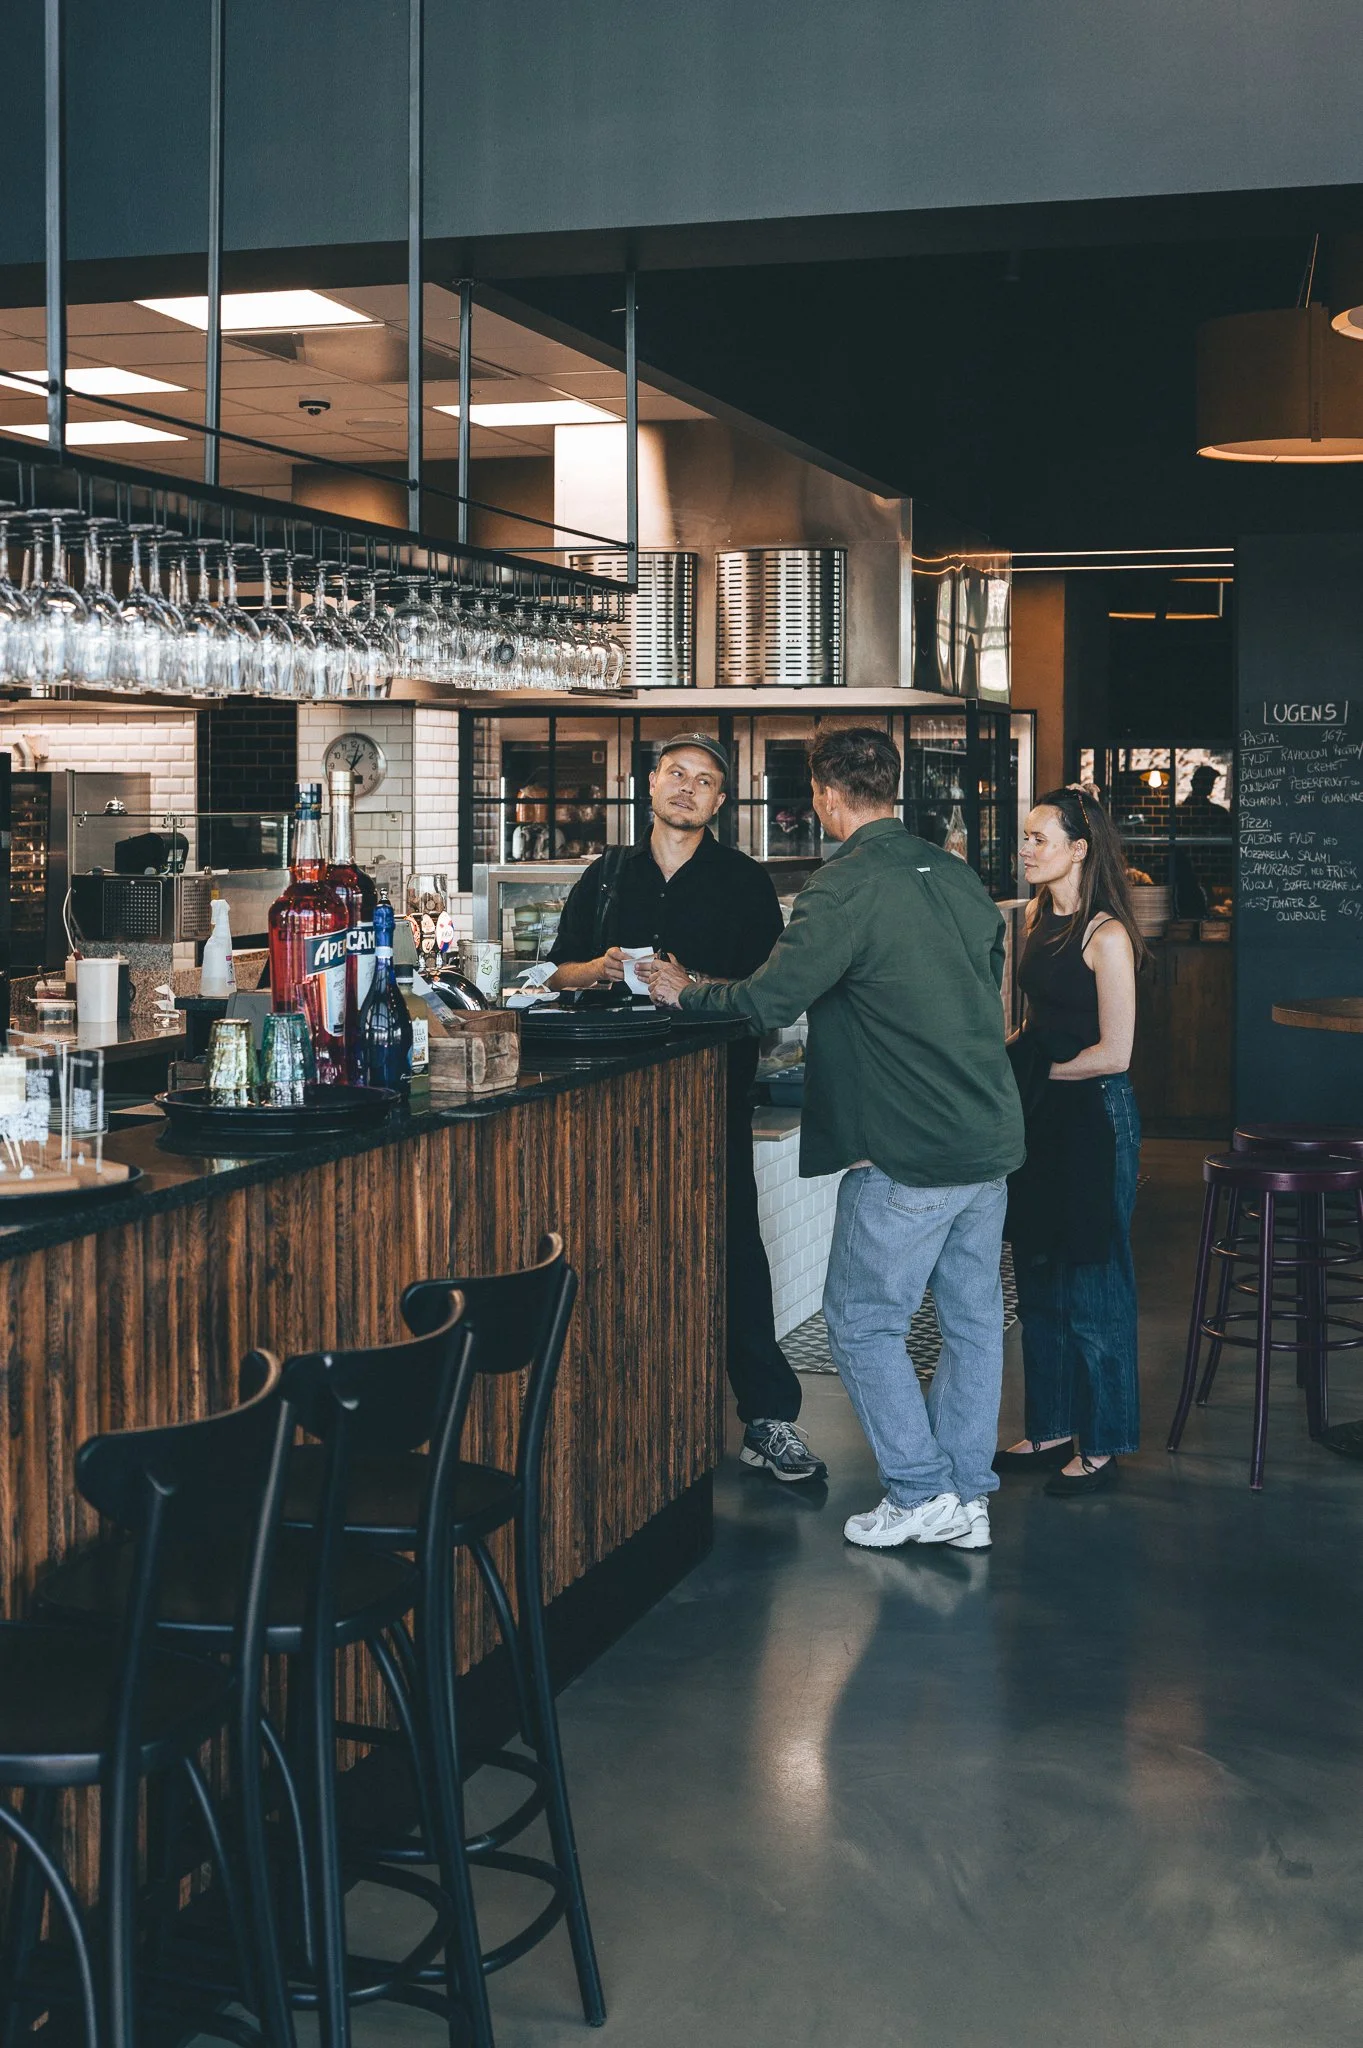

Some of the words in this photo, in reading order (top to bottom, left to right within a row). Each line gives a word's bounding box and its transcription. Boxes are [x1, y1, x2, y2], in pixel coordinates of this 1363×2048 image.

[1273, 703, 1337, 722] UGENS
[1240, 730, 1279, 746] PASTA:
[1240, 750, 1272, 765] FYLDT
[1239, 811, 1272, 829] PIZZA:
[1239, 833, 1283, 845] CALZONE
[1288, 831, 1316, 844] FYLDT
[1297, 850, 1330, 864] SALAMI
[1326, 865, 1358, 879] FRISK
[1267, 896, 1307, 909] TOMATER
[1307, 895, 1321, 908] &
